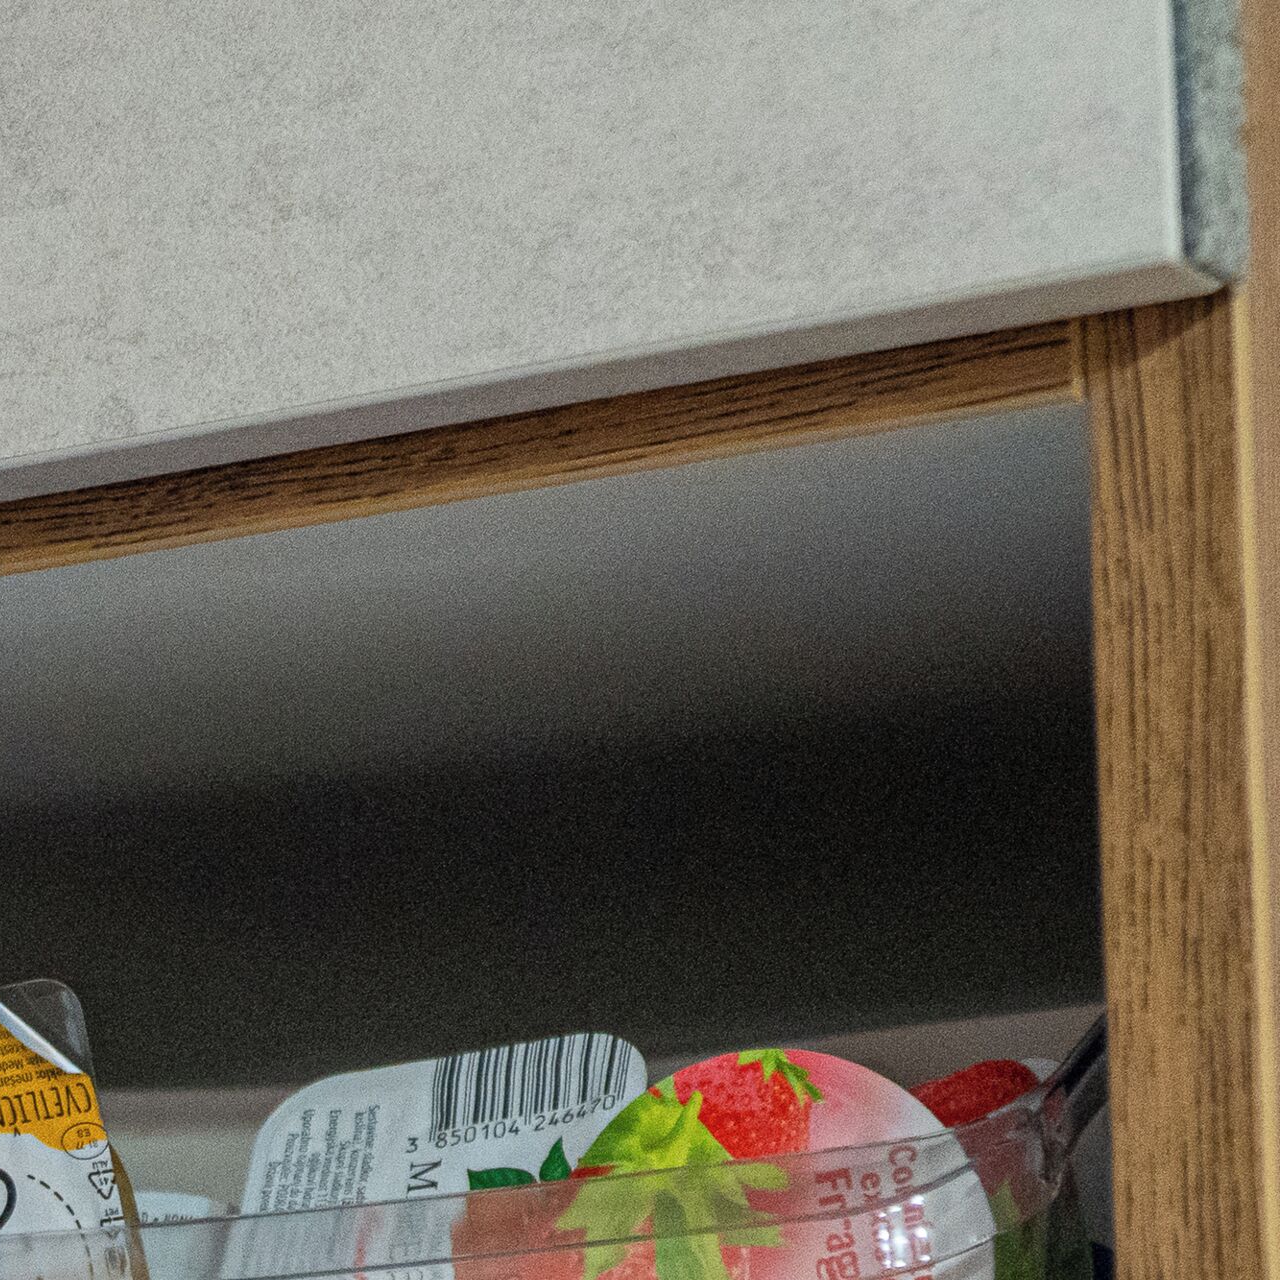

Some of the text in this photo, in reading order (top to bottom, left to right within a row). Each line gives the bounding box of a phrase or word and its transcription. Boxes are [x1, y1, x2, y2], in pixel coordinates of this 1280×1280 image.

[405, 1094, 616, 1154] 3 850104 246470
